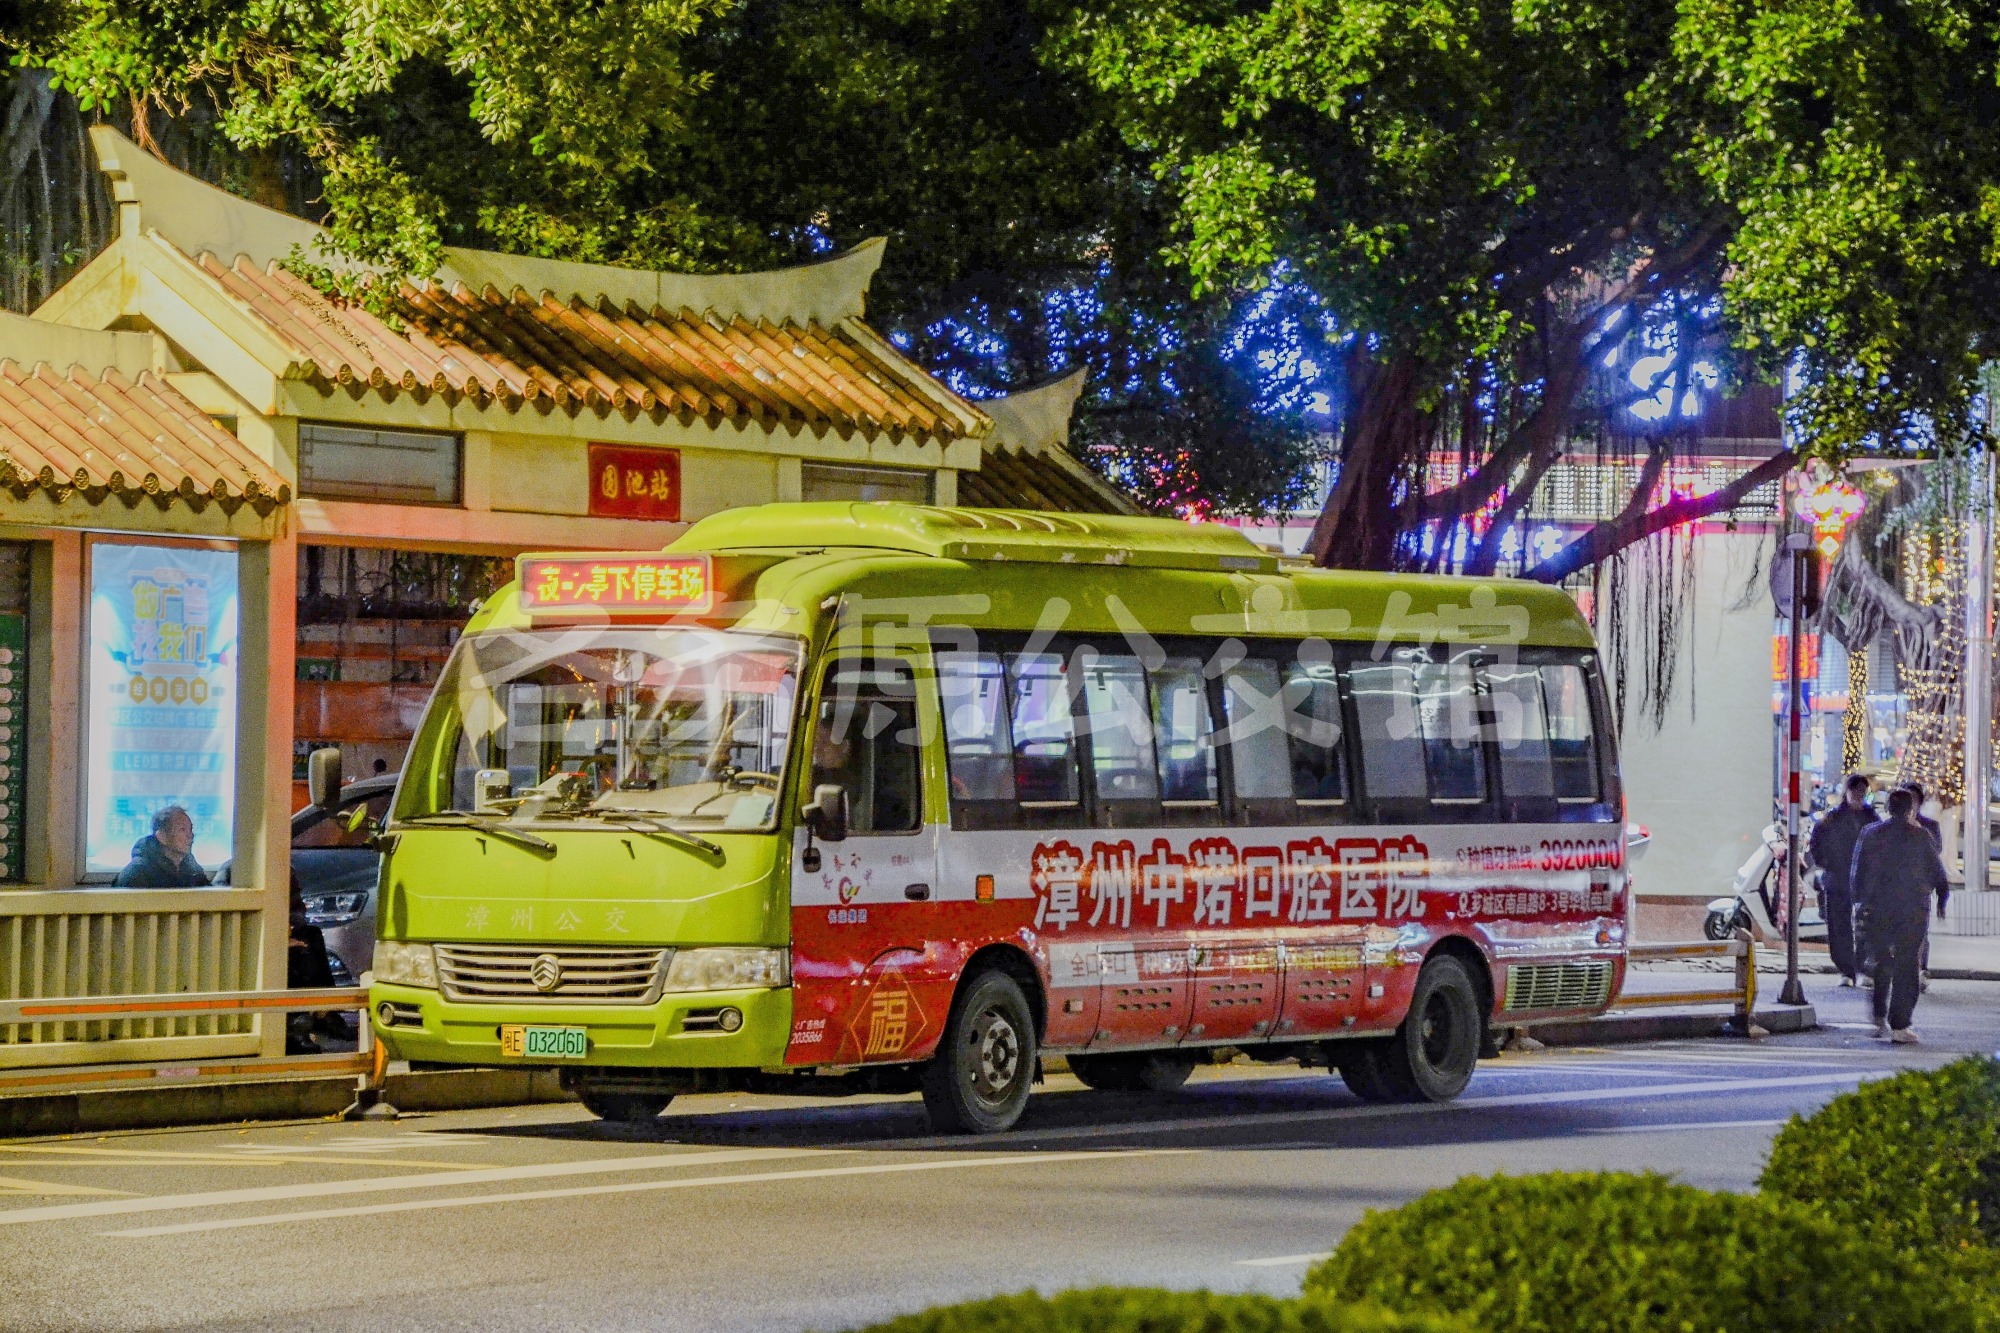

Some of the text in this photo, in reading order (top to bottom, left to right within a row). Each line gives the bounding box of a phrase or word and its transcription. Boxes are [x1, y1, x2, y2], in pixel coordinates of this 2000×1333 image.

[132, 580, 208, 623] 做广告
[132, 621, 207, 662] 找我们
[1034, 842, 1428, 931] 漳州中诺口腔医院
[465, 905, 630, 933] 漳州公交
[865, 991, 908, 1055] 福
